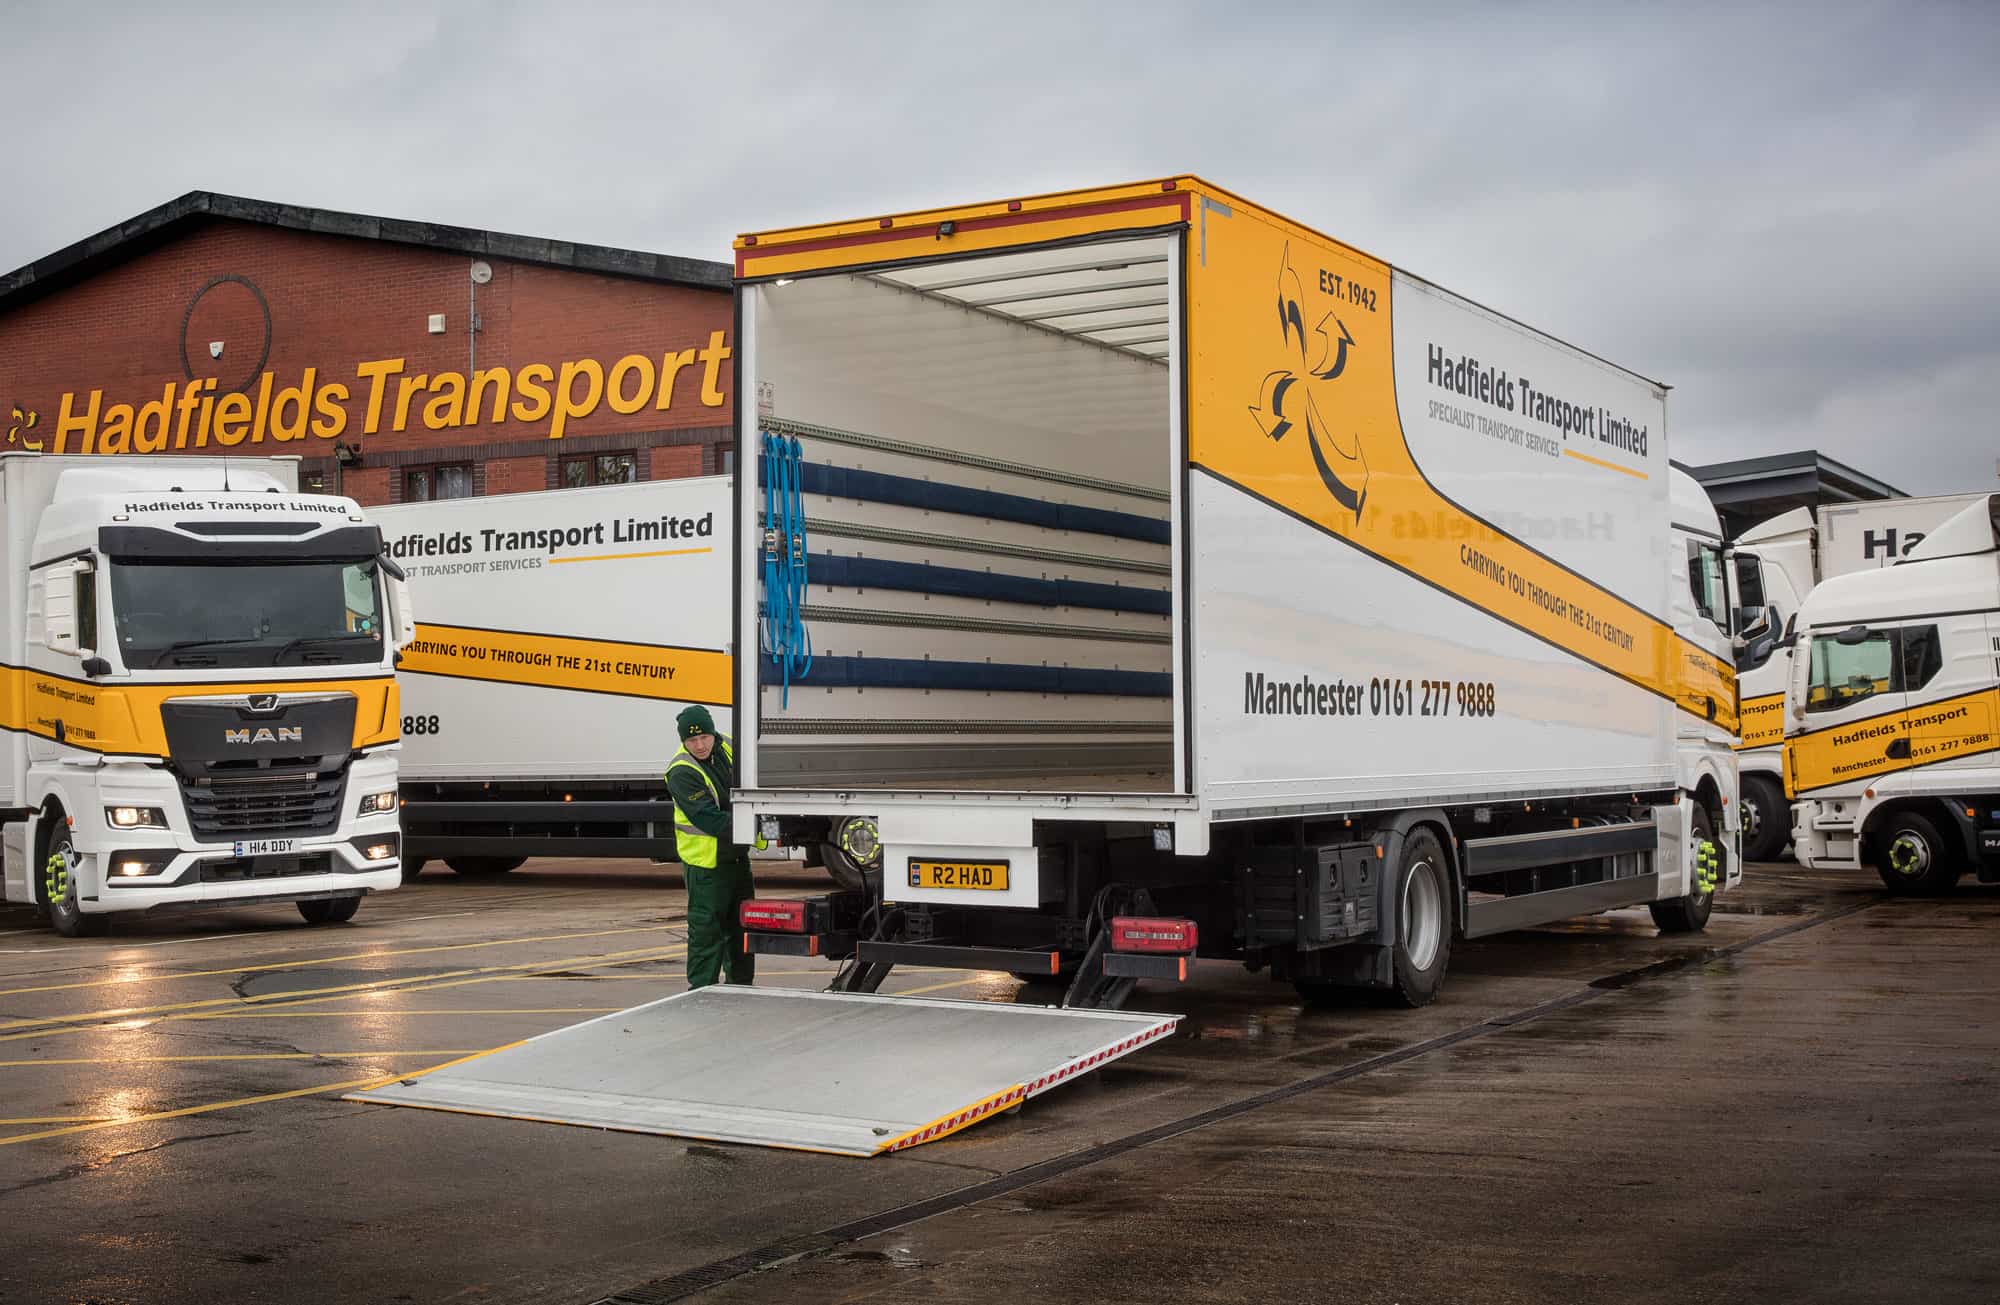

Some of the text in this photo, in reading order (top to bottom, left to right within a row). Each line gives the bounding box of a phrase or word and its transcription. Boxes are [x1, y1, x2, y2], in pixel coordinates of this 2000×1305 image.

[1319, 268, 1376, 313] EST. 1942
[52, 330, 732, 455] Hadfields Transport
[1427, 342, 1648, 457] Hadfields Transport Limited
[1428, 400, 1560, 458] SPECIALIST TRANSPORT SERVICES
[124, 501, 347, 515] Hadfields Transport Limited
[383, 512, 713, 559] adfields Transport Limited
[420, 561, 486, 577] TRANSPORT
[488, 557, 542, 573] SERVICES
[1460, 543, 1633, 653] CARRYING YOU THROUGH THE 21st CENTURY
[401, 641, 675, 680] ARRYING YOU THROUGH THE 21st CENTURY
[1243, 671, 1495, 718] Manchester 0161 277 9888
[225, 727, 303, 744] MAN
[400, 714, 439, 735] 888
[1744, 731, 1765, 740] 0161
[1832, 706, 1968, 747] Hadfields Transport
[1832, 733, 1990, 775] Manchester 0161 277 9888
[271, 840, 294, 852] DDY
[933, 866, 955, 885] R2
[959, 867, 993, 886] HAD
